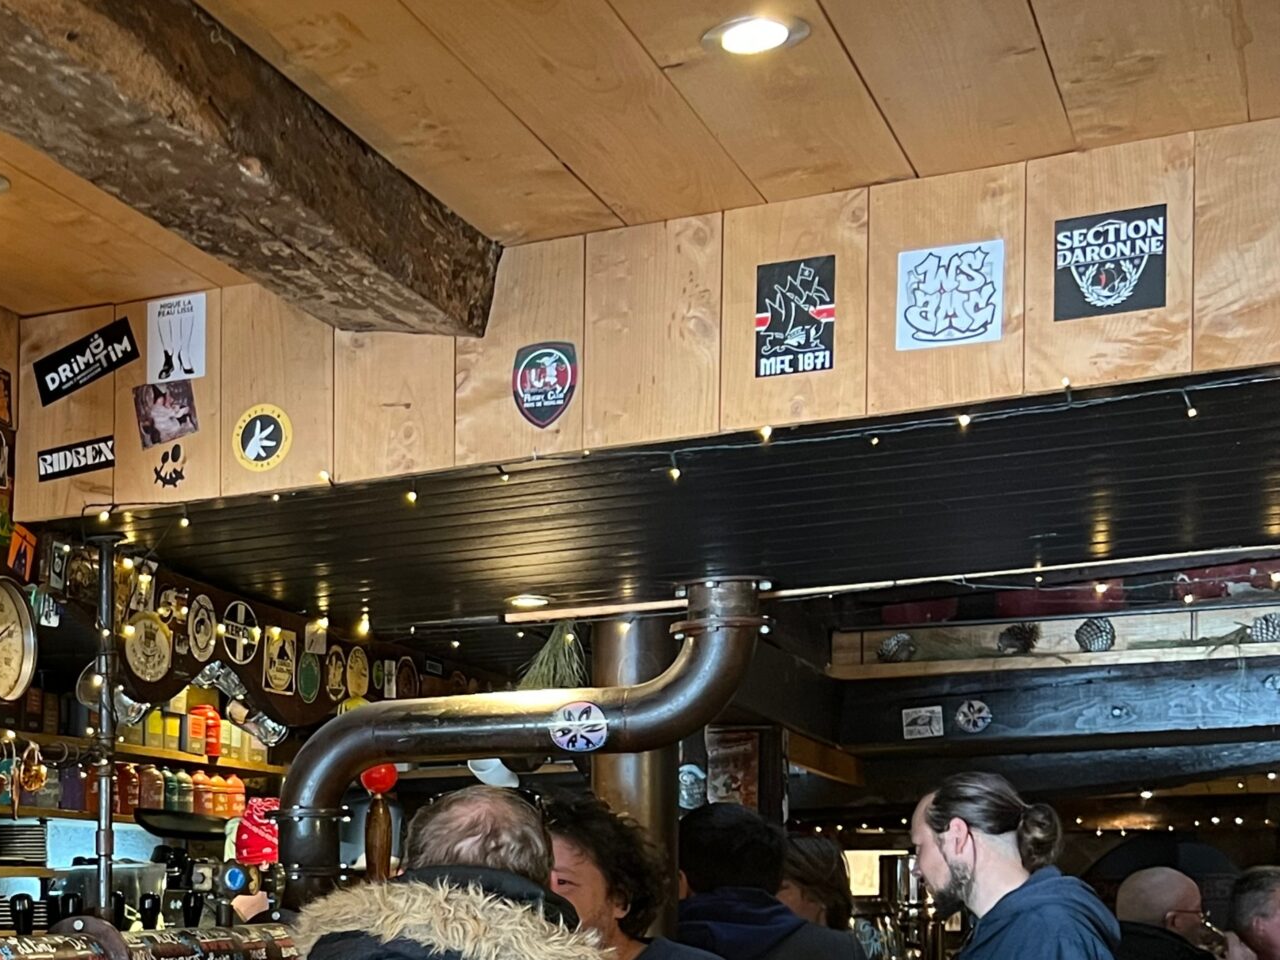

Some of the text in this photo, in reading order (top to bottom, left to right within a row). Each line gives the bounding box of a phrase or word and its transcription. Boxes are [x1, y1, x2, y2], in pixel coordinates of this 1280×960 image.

[1055, 215, 1165, 250] SECTION
[759, 350, 831, 376] MFC 1871
[38, 439, 115, 476] RIDBEX
